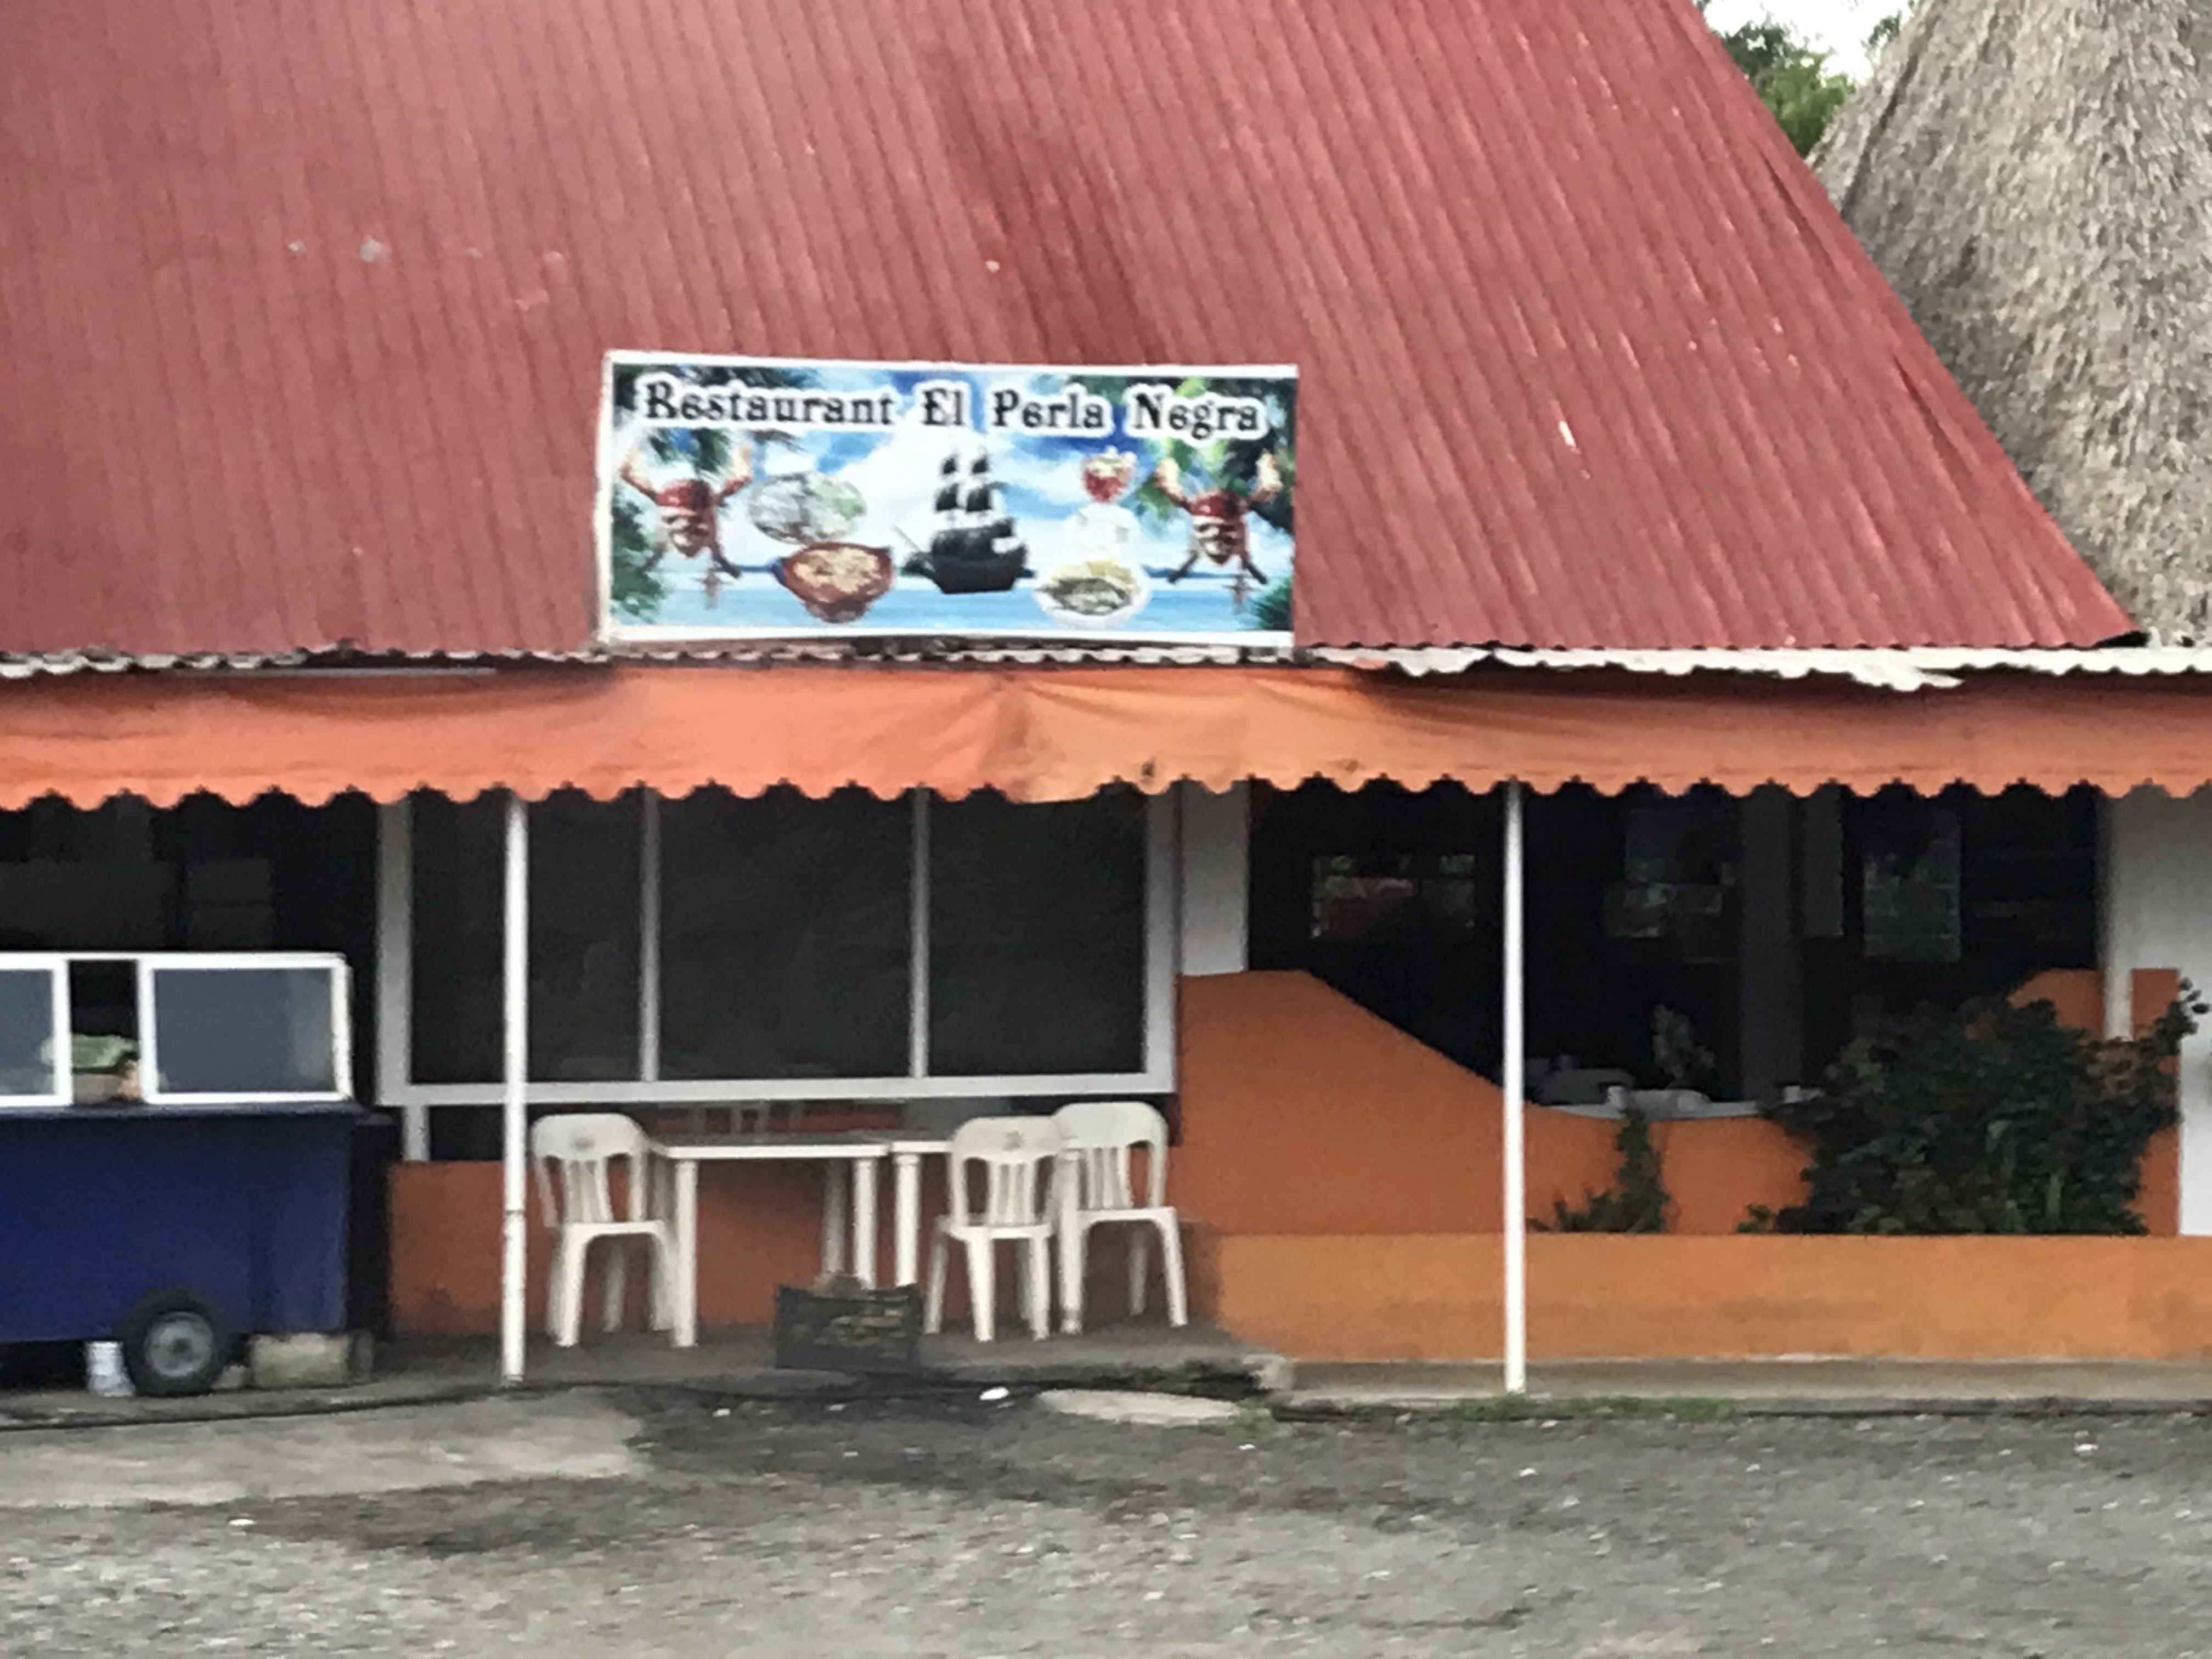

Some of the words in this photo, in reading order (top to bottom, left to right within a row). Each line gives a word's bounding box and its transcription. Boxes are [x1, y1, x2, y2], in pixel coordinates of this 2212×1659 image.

[646, 381, 894, 425] Restaurant
[922, 388, 965, 426] El
[992, 388, 1104, 428] Perla
[1133, 392, 1260, 440] Negra
